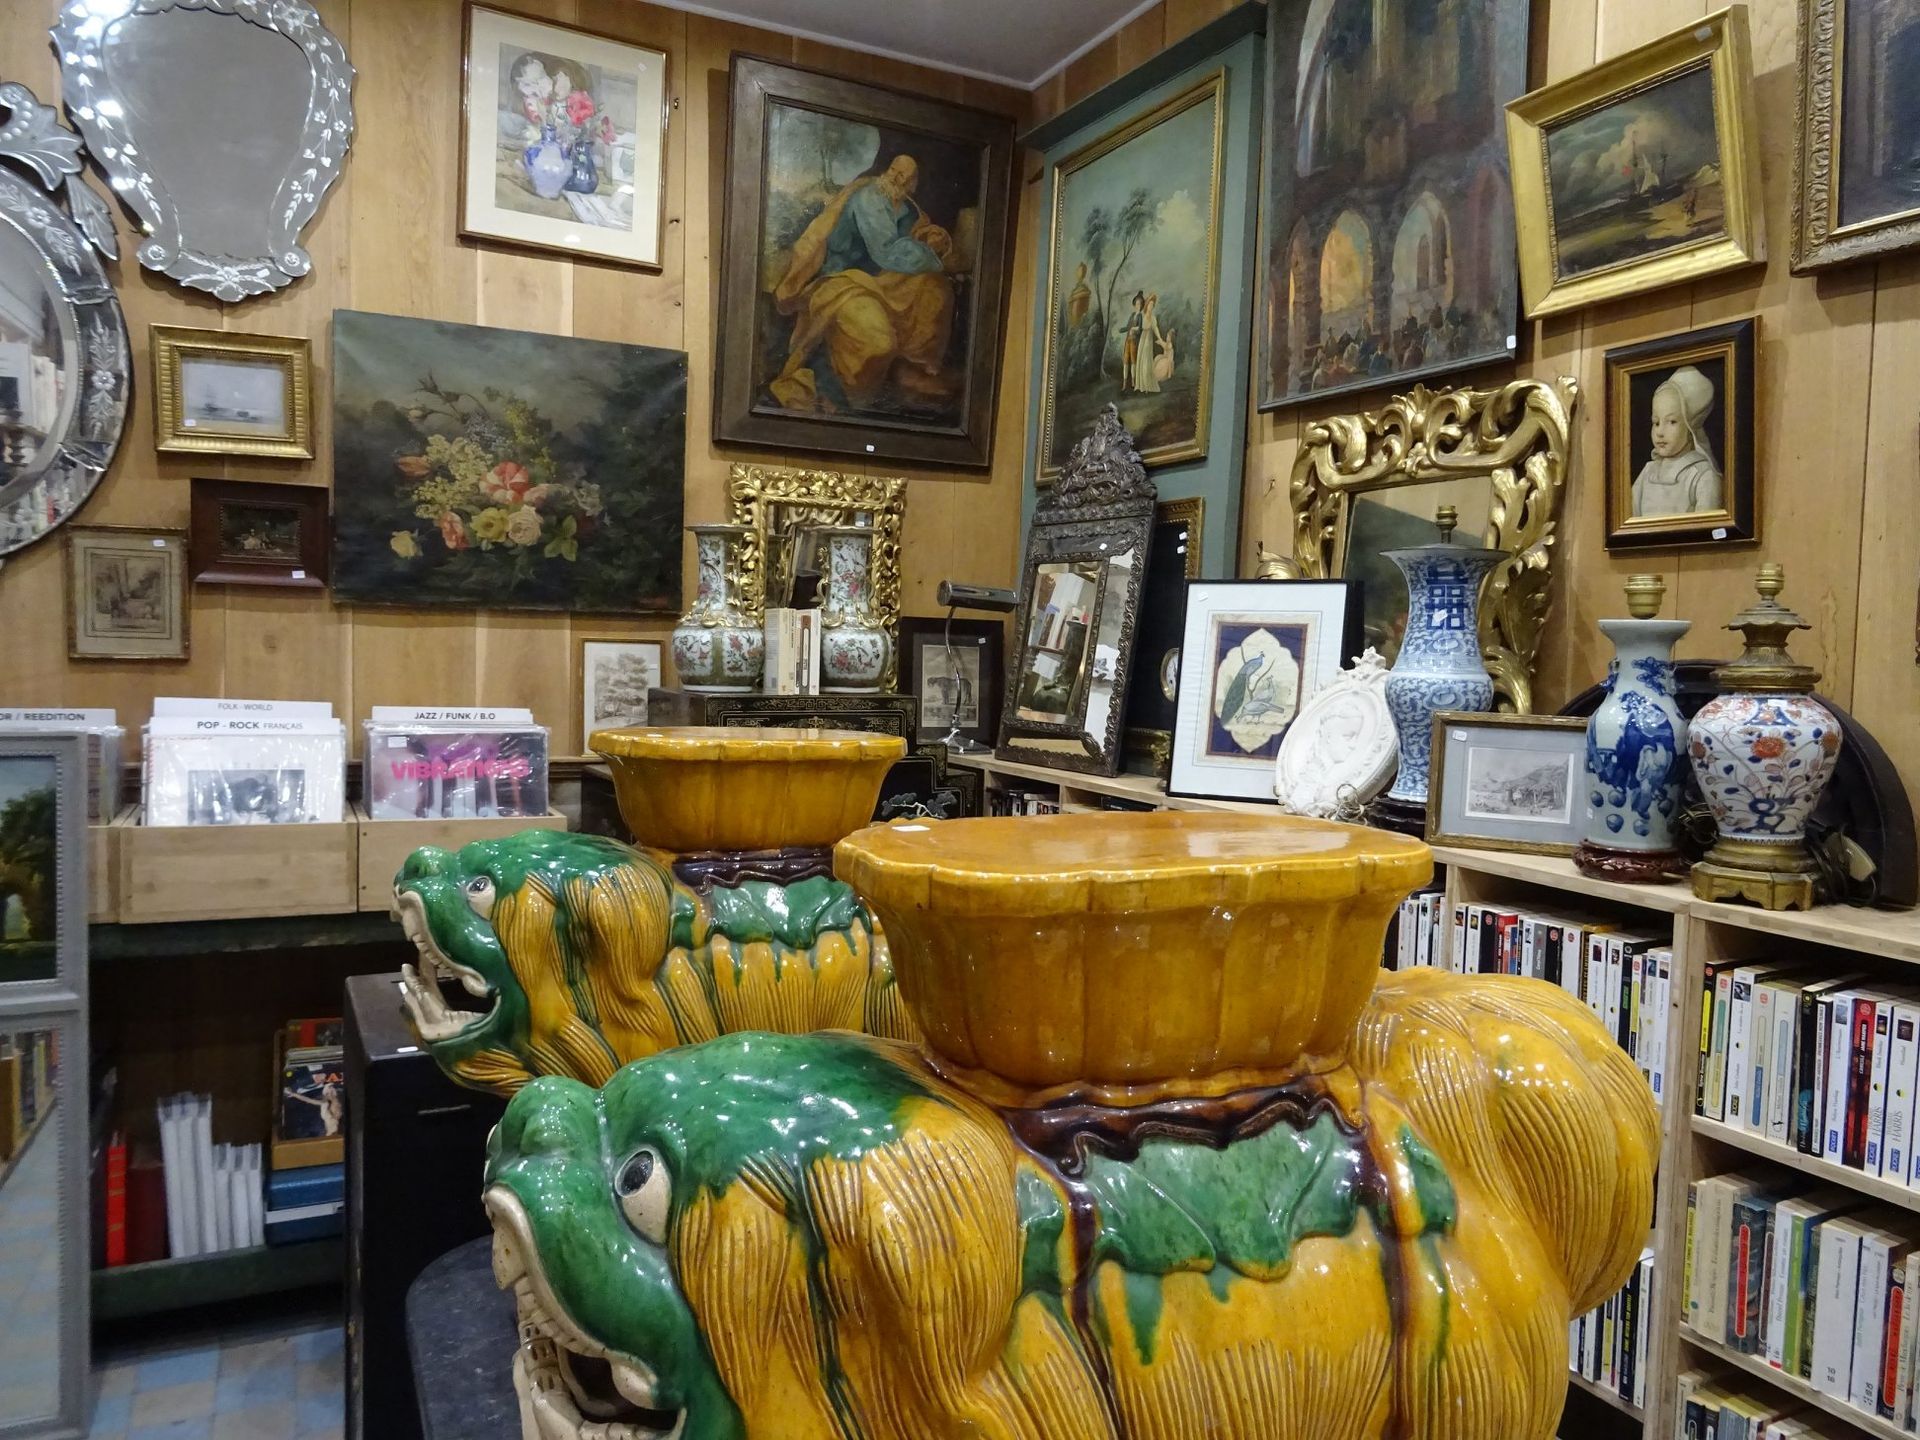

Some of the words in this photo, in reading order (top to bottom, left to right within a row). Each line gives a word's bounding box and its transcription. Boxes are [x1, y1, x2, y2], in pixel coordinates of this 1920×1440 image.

[217, 702, 239, 711] FOLK
[244, 703, 273, 711] WORLD
[24, 713, 85, 721] REEDITION
[414, 712, 437, 720] JAZZ
[446, 712, 471, 720] FUNK
[197, 721, 219, 730] POP
[229, 721, 259, 730] ROCK
[1871, 1106, 1882, 1135] HARRIS
[1889, 1110, 1903, 1142] HARRIS
